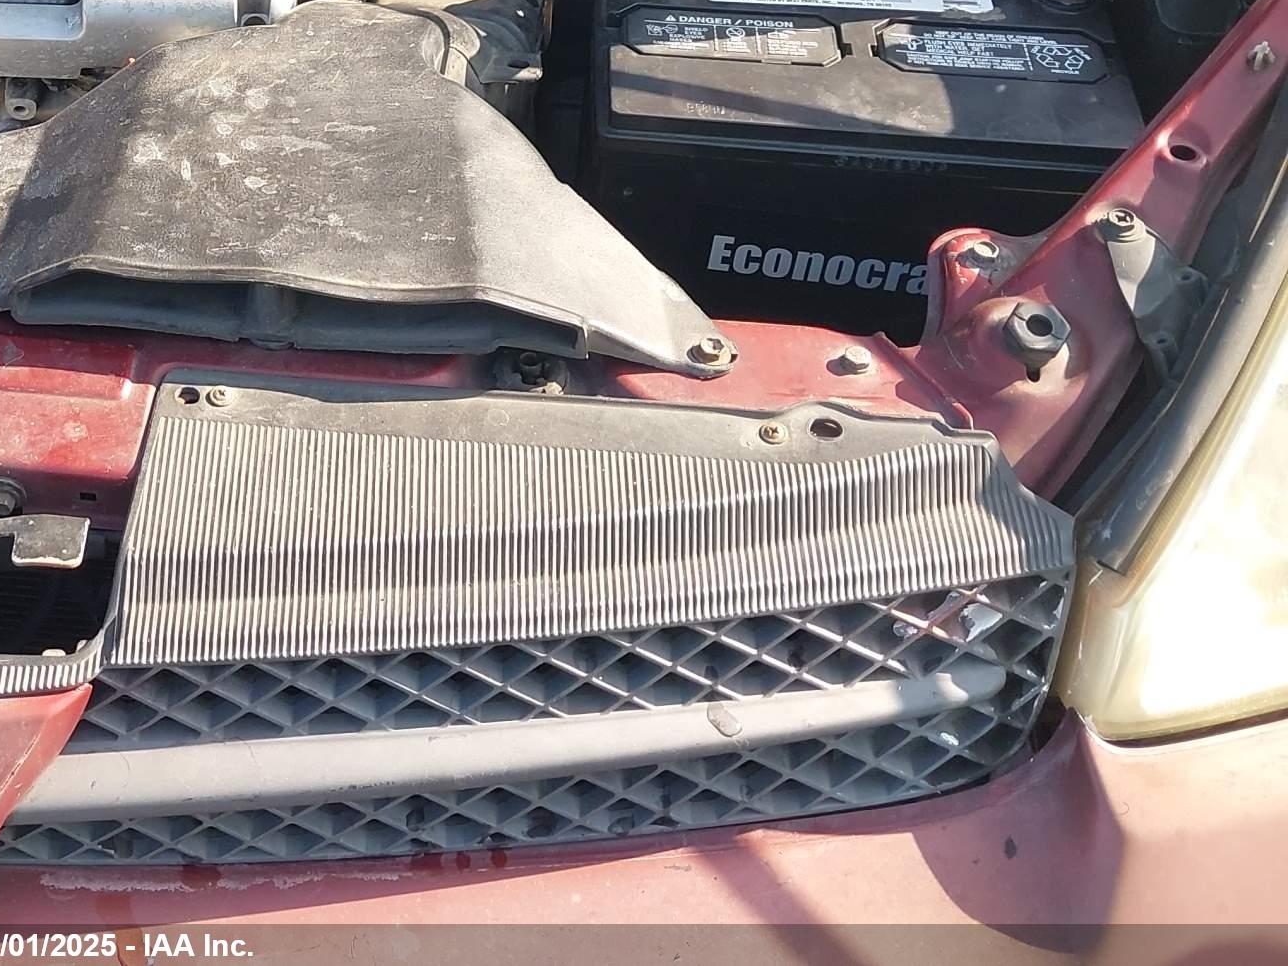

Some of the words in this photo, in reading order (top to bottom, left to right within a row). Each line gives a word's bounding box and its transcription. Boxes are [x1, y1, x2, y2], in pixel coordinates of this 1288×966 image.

[678, 15, 732, 26] DANGER
[745, 19, 794, 28] POISON
[967, 42, 1013, 50] IMMEDIATELY
[706, 234, 928, 296] Econocra
